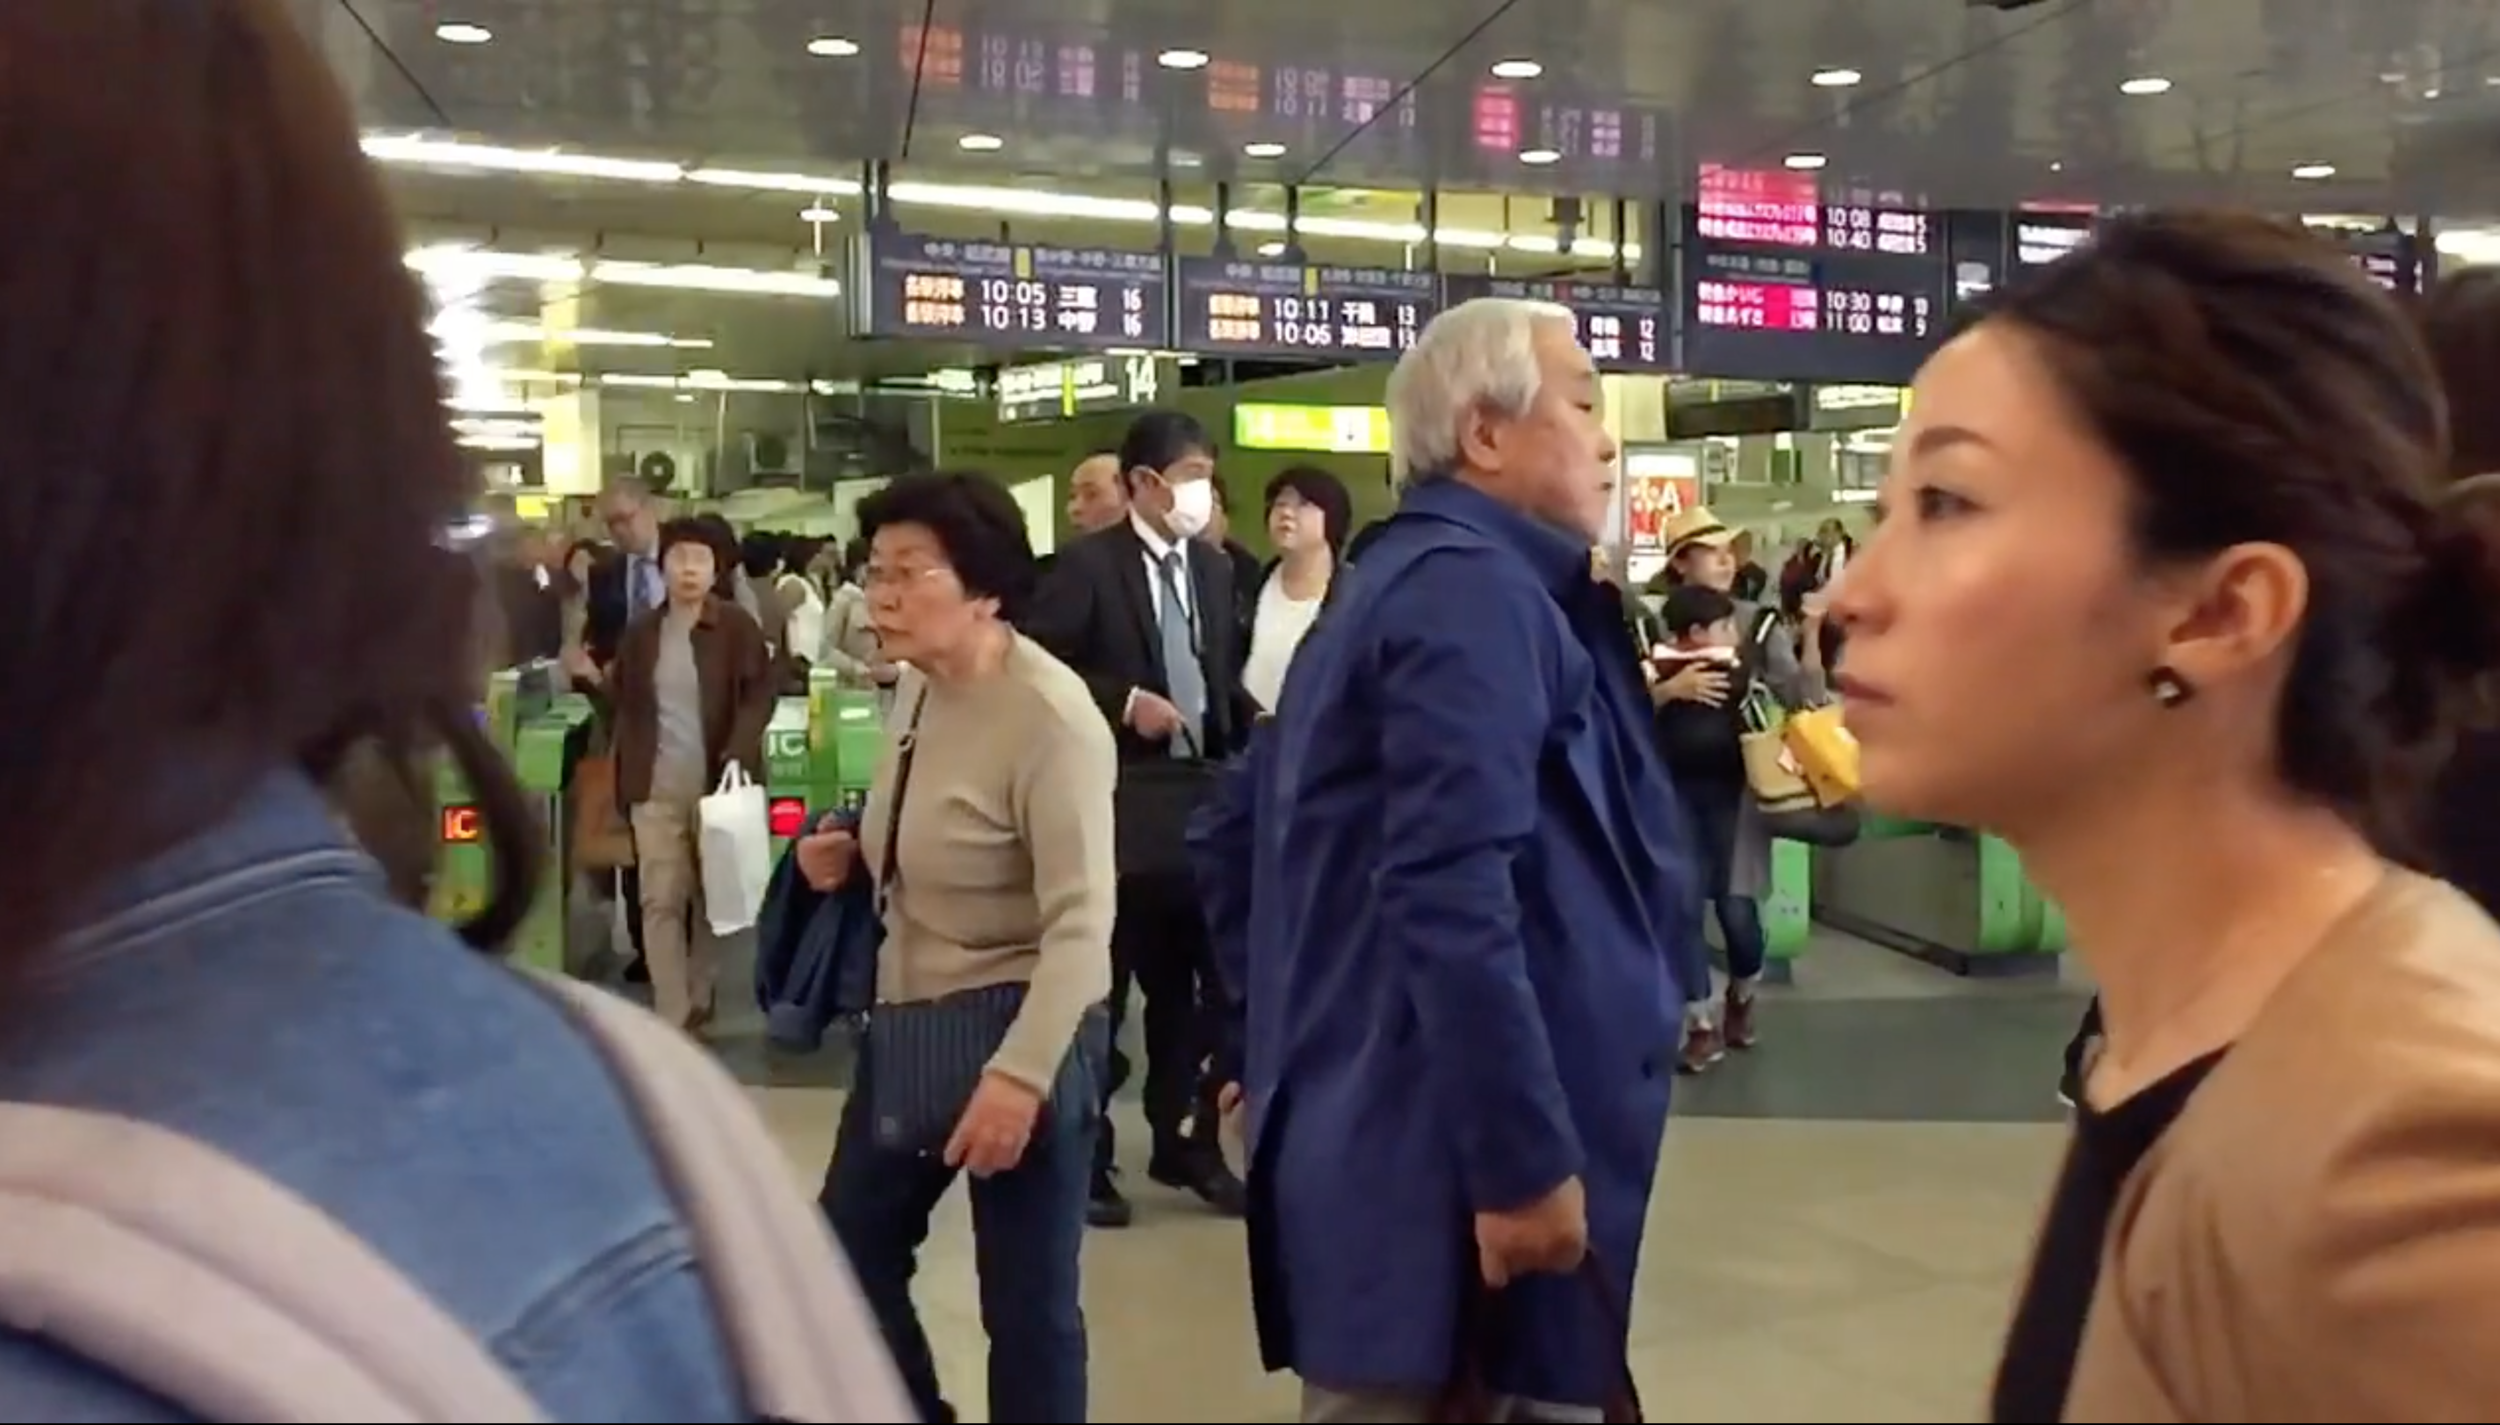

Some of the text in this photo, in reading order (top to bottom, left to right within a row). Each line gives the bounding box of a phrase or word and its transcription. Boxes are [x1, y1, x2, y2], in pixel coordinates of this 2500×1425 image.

[981, 279, 1045, 307] 10:05
[1122, 288, 1142, 312] 16
[1827, 291, 1872, 313] 10:30
[981, 306, 1045, 331] 10:13
[1122, 313, 1142, 337] 16
[1275, 298, 1329, 321] 10:11
[1275, 322, 1331, 346] 10:05
[1827, 312, 1872, 334] 11:00
[1125, 354, 1156, 404] 14
[768, 733, 807, 758] IC
[444, 809, 478, 840] IC
